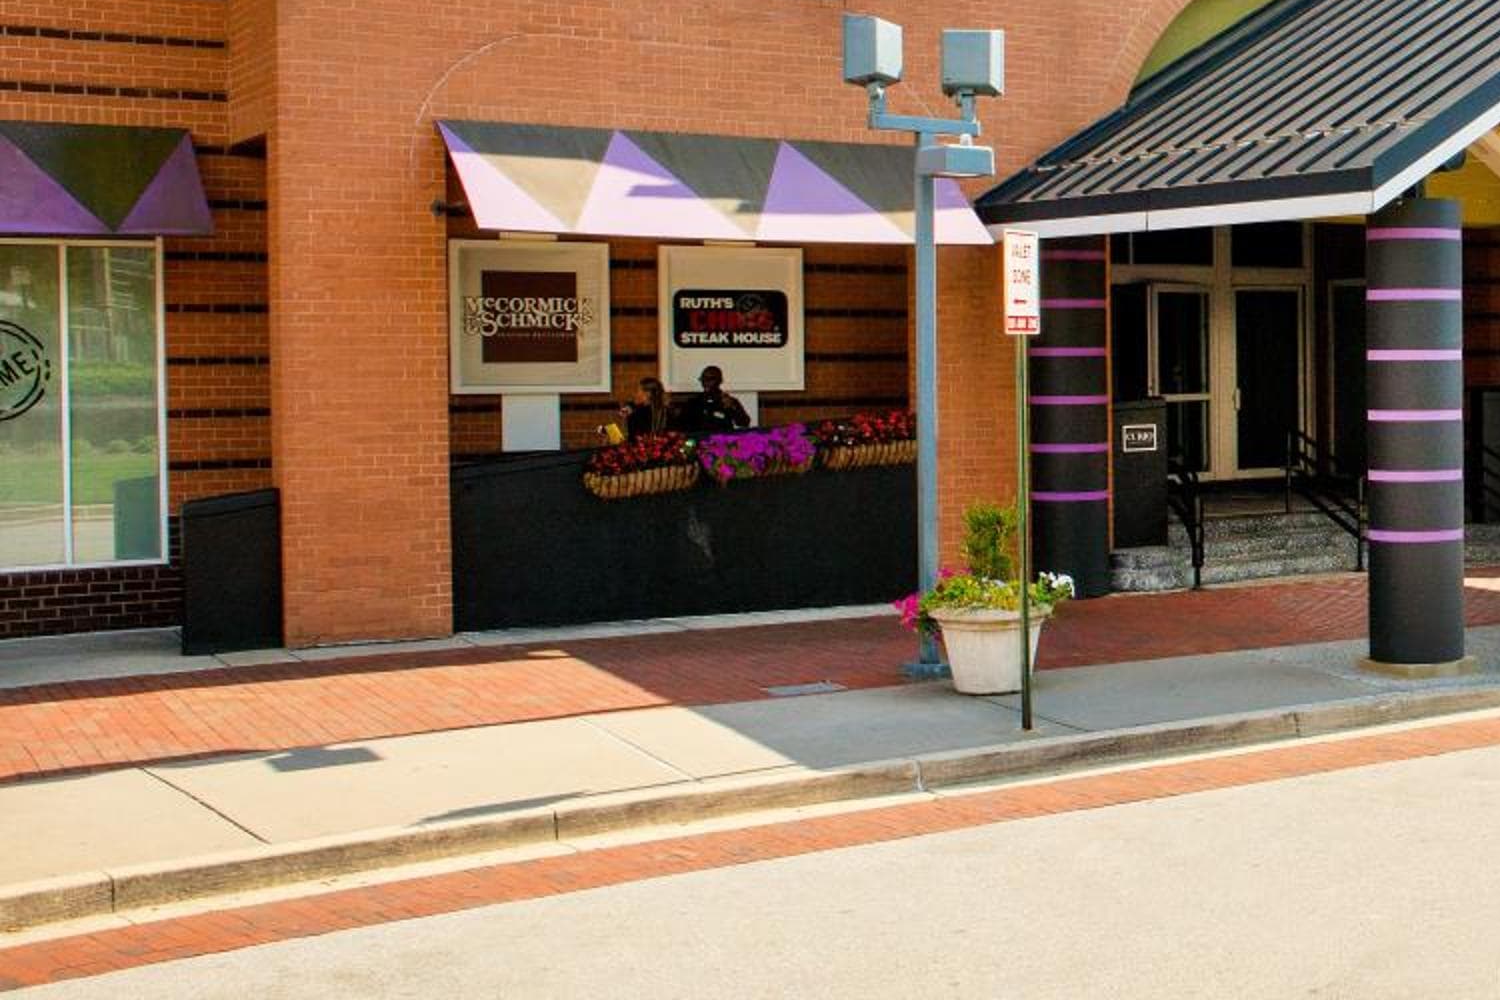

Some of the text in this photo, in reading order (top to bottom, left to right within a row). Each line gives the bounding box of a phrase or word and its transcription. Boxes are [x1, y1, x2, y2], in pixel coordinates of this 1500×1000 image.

[680, 297, 735, 309] RUTH'S
[680, 332, 783, 344] STEAK HOUSE
